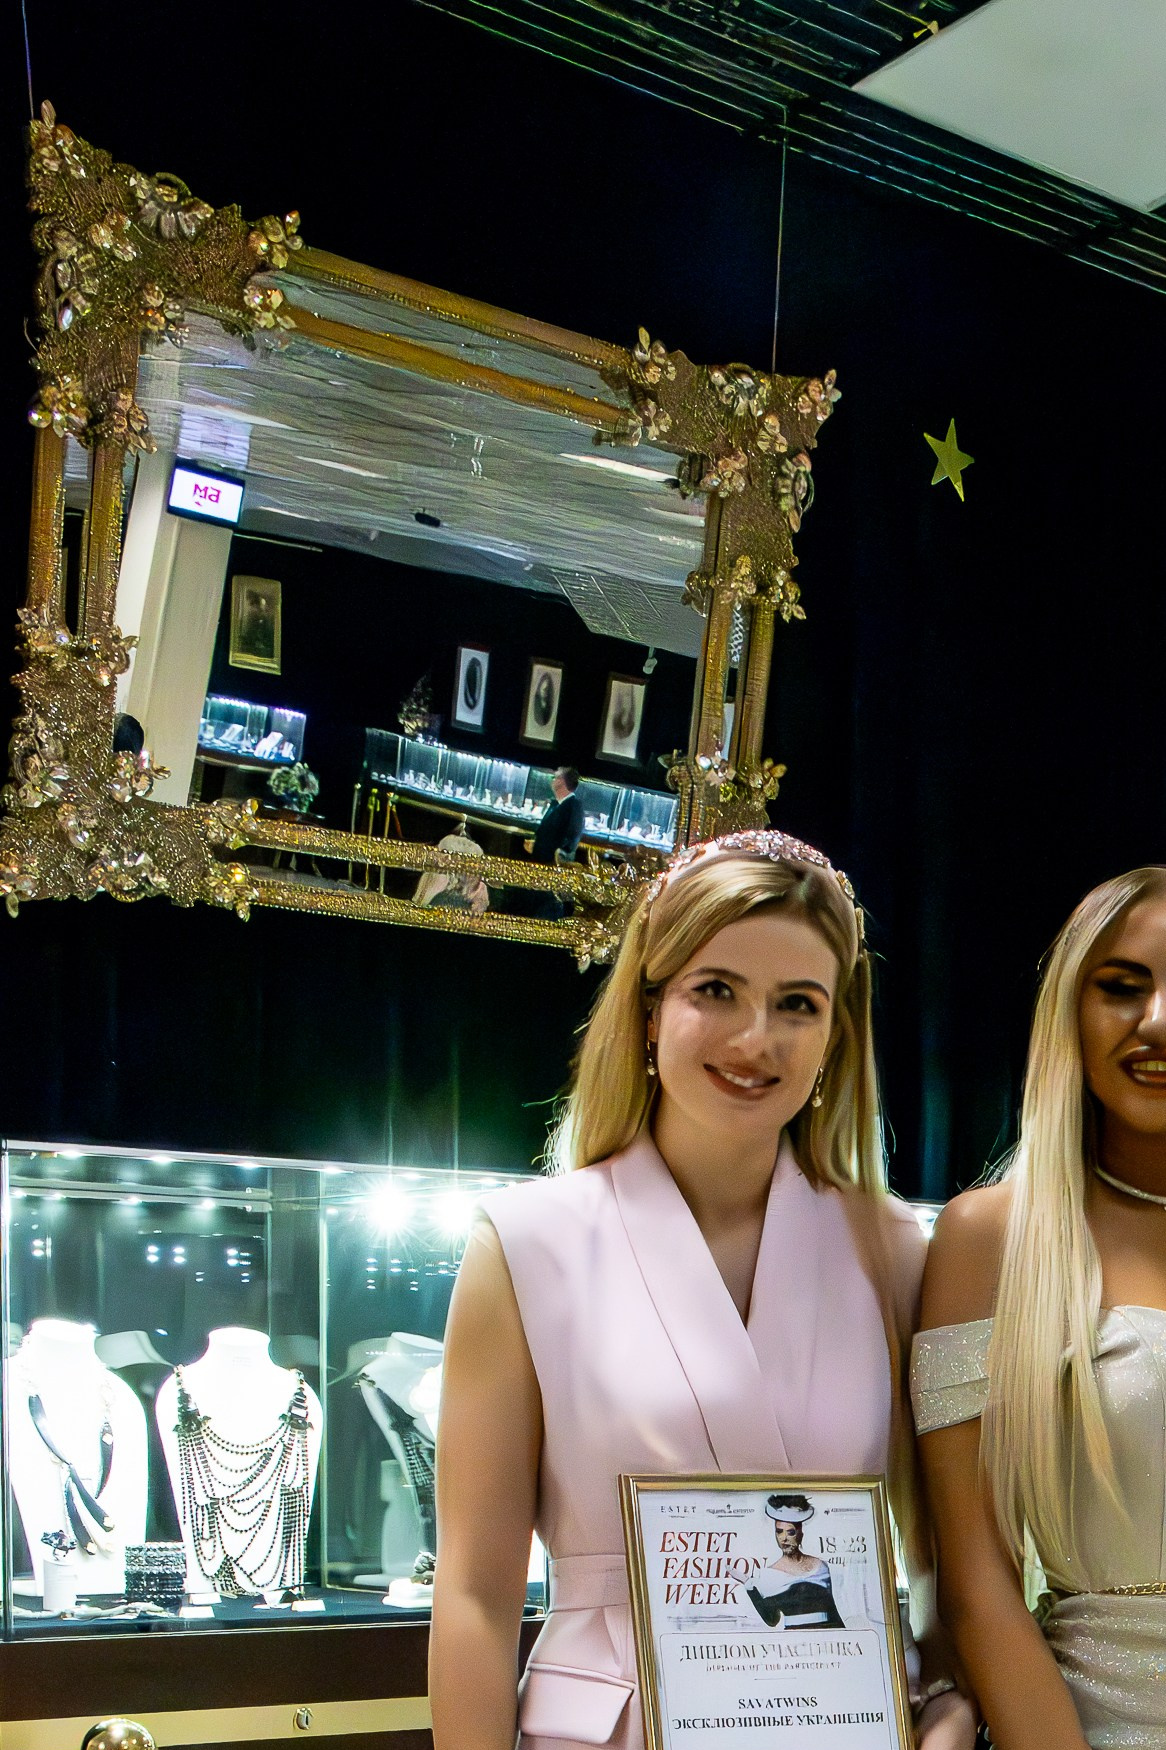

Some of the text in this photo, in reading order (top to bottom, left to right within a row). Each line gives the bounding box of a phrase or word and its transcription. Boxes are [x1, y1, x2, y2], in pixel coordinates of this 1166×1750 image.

[659, 1531, 738, 1553] ESTET
[662, 1556, 768, 1579] FASHION
[665, 1583, 739, 1605] WEEK
[679, 1644, 756, 1662] ДИПЛОМ
[738, 1696, 819, 1710] SAVATWINS
[672, 1711, 885, 1730] ЭКСКЛЮЗИВНЫЕ УКРАШЕНИЯ
